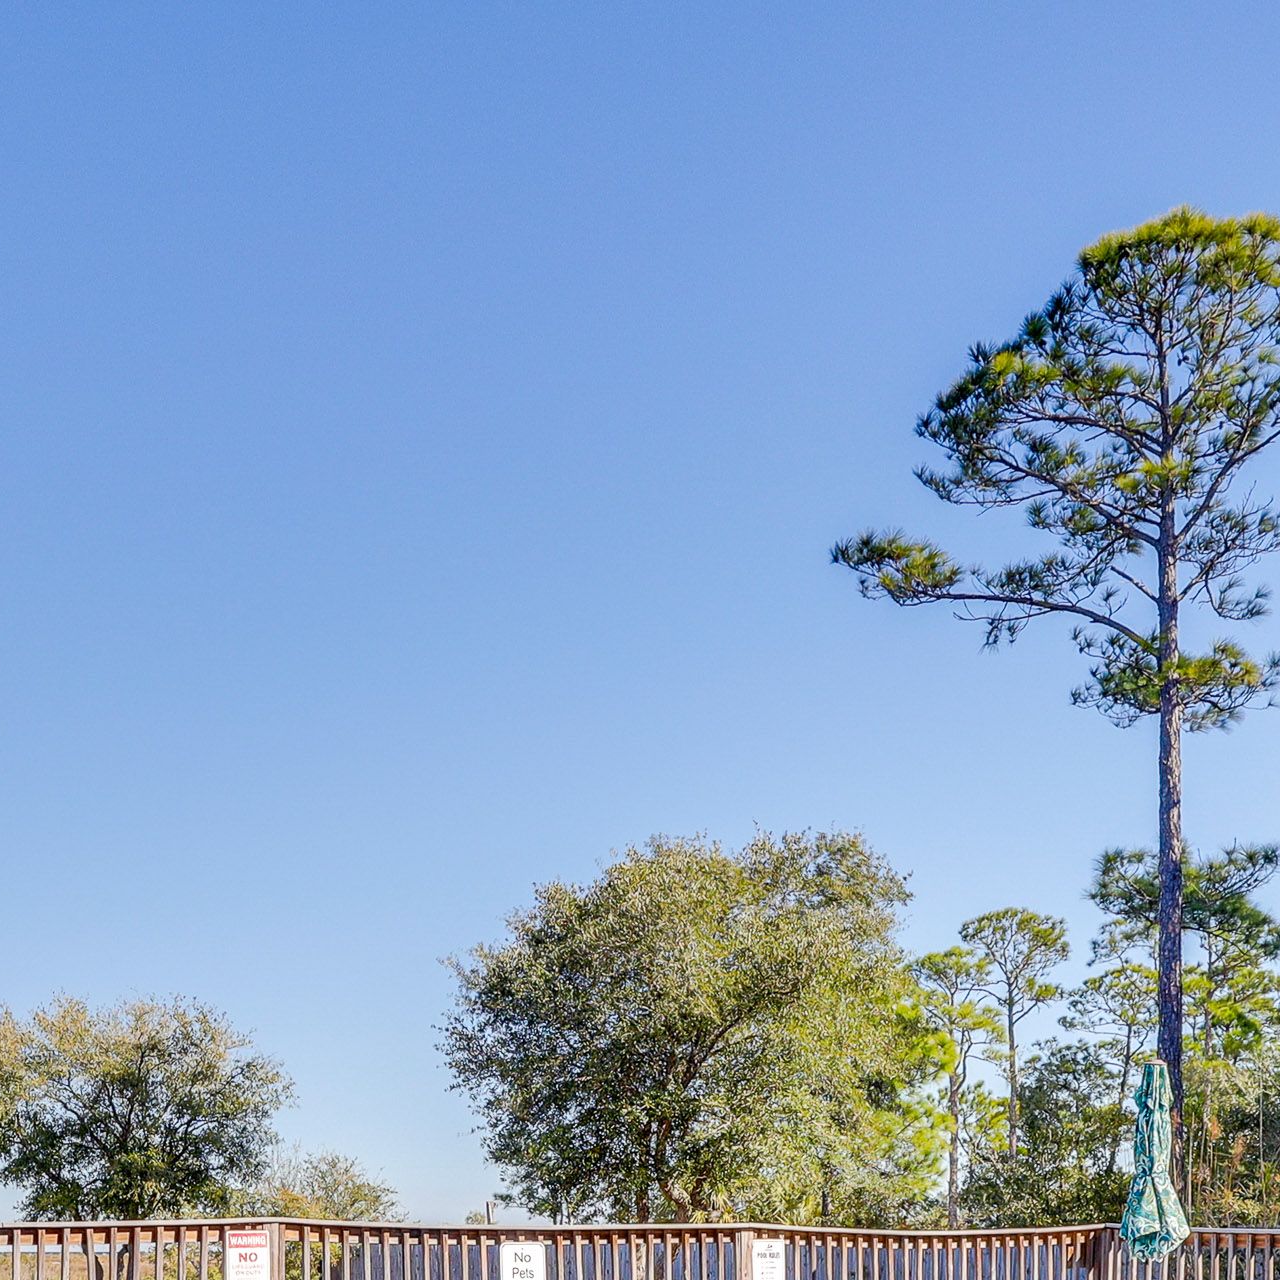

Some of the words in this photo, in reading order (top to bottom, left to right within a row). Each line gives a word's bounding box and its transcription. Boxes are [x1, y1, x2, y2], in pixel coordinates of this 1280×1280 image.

[230, 1235, 265, 1246] WARNING
[239, 1252, 258, 1262] NO
[514, 1252, 531, 1263] No
[512, 1267, 535, 1279] Pets
